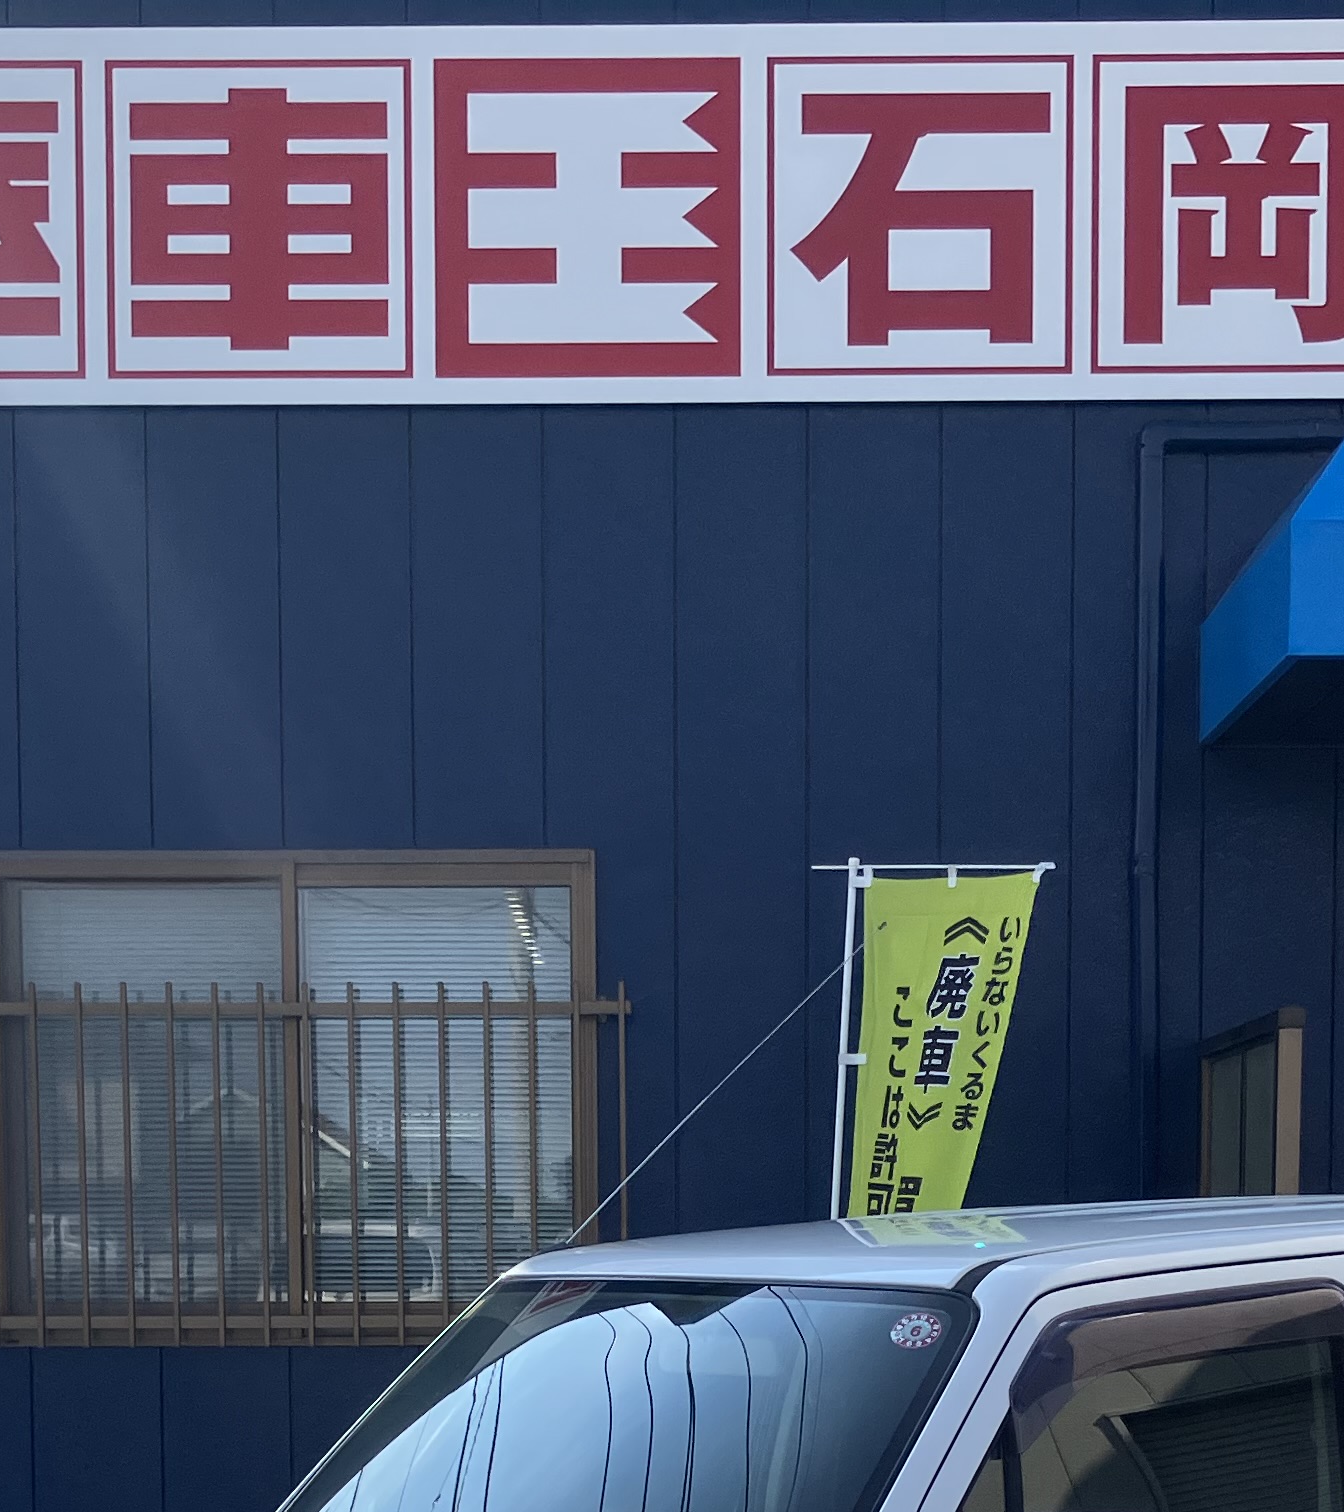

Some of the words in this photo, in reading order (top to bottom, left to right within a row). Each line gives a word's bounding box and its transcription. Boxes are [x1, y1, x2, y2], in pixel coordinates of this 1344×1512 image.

[951, 915, 1021, 1132] いらないくるま
